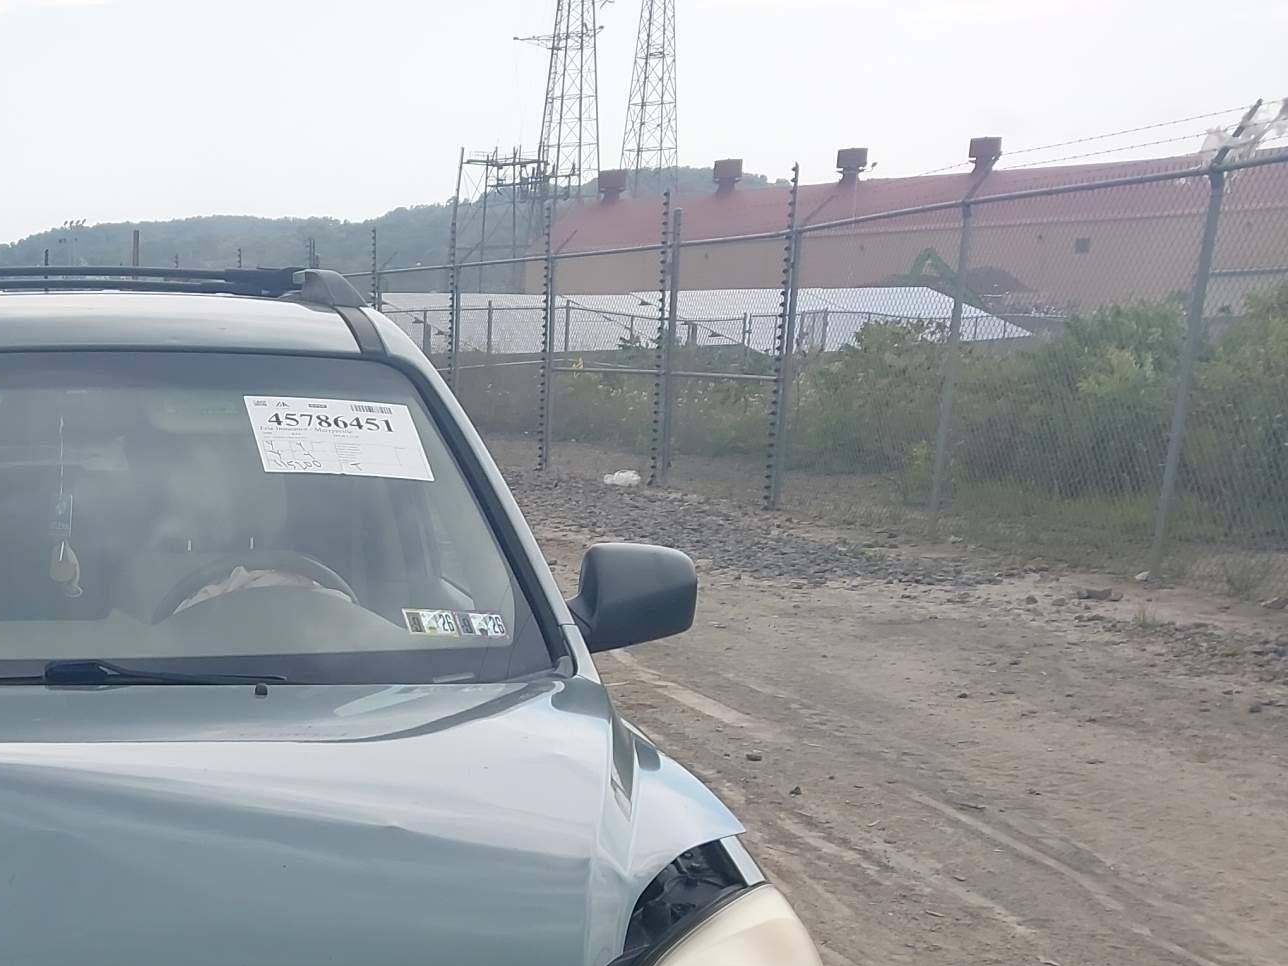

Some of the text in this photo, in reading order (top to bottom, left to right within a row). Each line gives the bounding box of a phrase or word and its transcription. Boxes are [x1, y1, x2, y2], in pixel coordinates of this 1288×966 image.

[268, 412, 394, 433] 45786451
[439, 614, 455, 632] 26
[488, 615, 505, 634] 26
